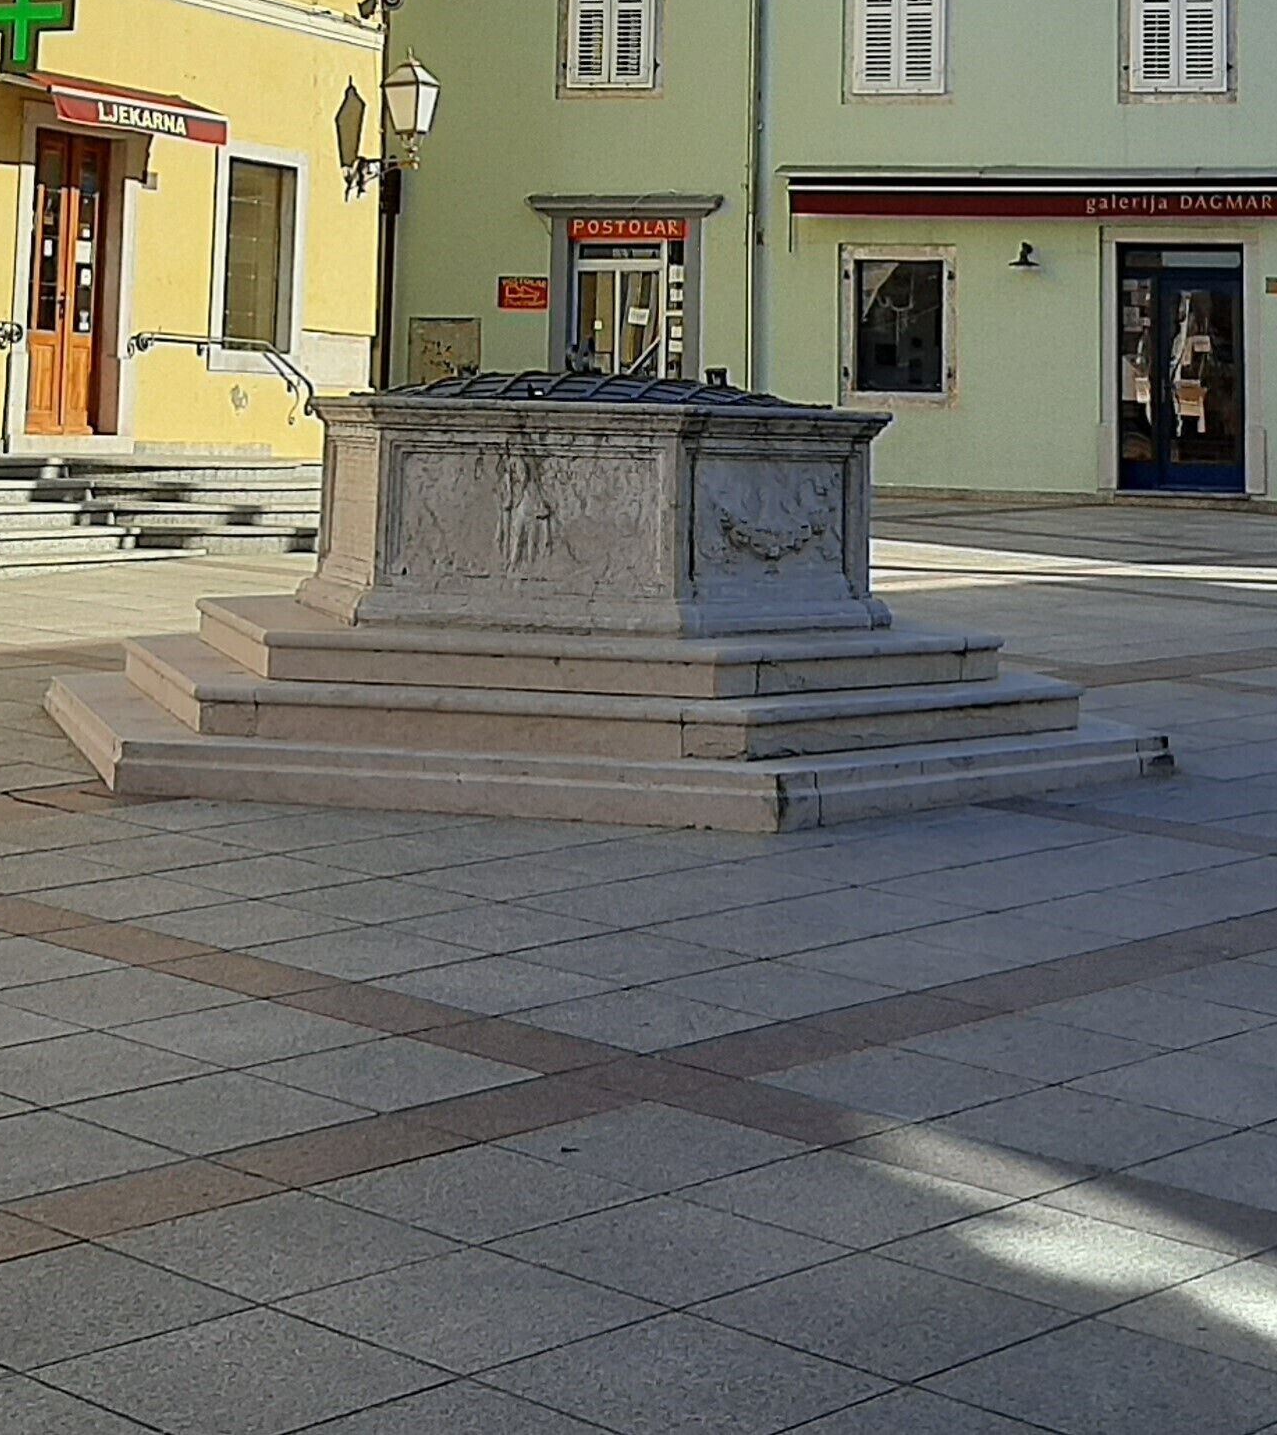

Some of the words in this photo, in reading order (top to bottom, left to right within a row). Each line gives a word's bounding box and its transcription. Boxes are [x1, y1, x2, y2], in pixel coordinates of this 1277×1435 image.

[97, 101, 187, 136] LJEKARNA
[1086, 194, 1168, 214] galerija
[1180, 195, 1273, 210] DAGMAR
[573, 219, 678, 235] POSTOLAR
